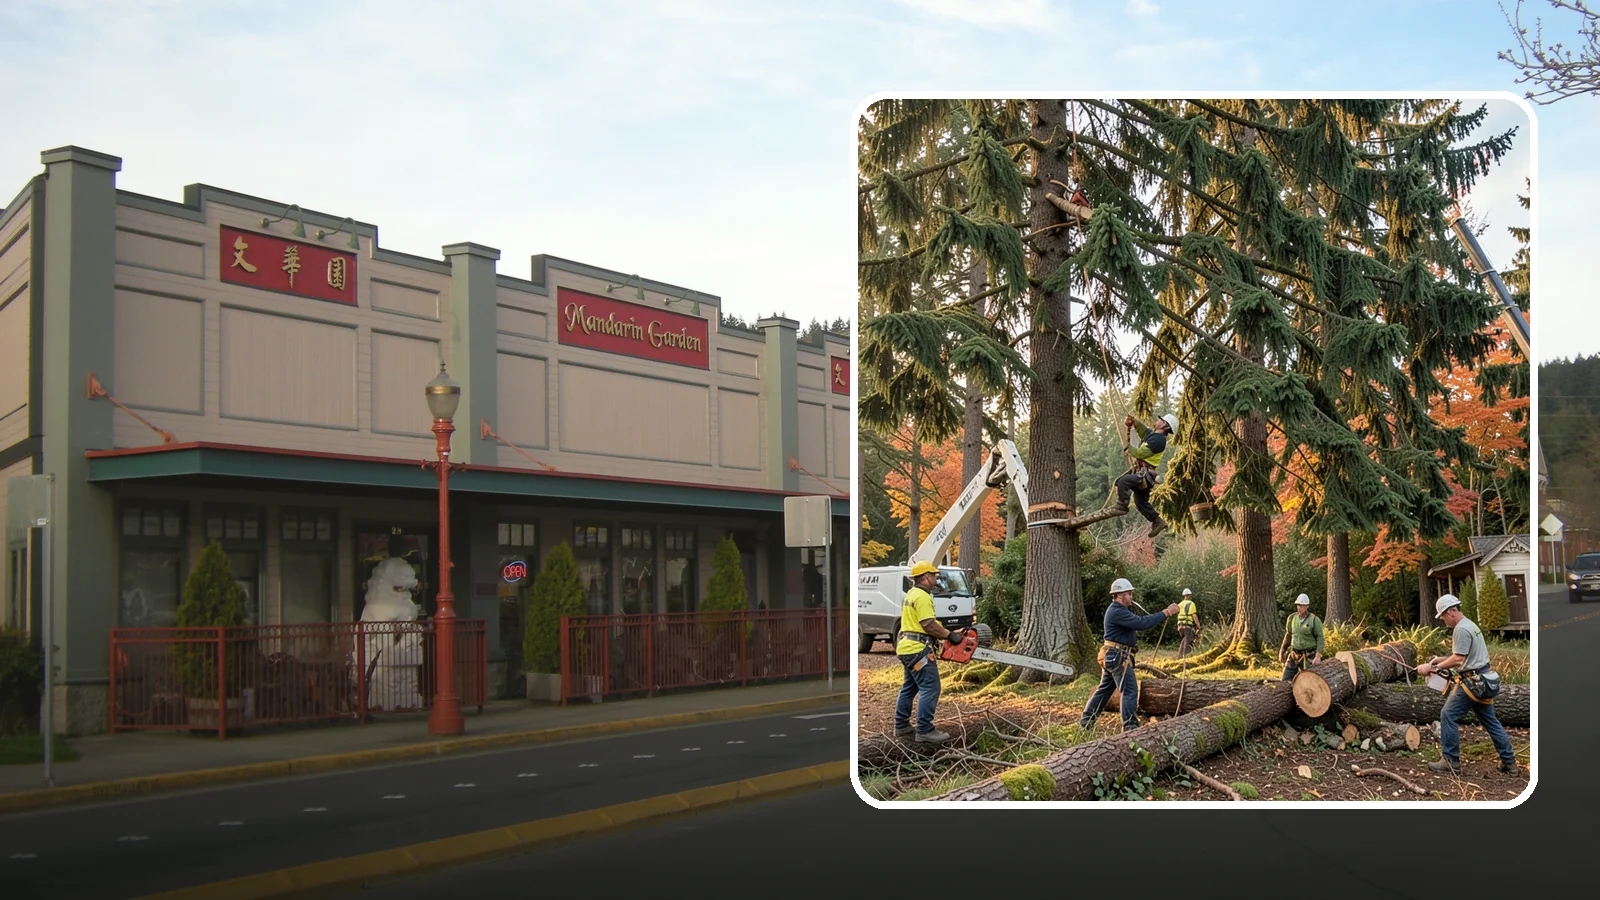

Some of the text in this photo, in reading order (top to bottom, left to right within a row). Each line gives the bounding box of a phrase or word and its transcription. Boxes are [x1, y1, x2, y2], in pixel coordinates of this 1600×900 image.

[231, 236, 346, 291] 文華園
[565, 302, 702, 352] Mandarin Garden
[835, 363, 846, 386] 文
[503, 565, 527, 578] OPEN
